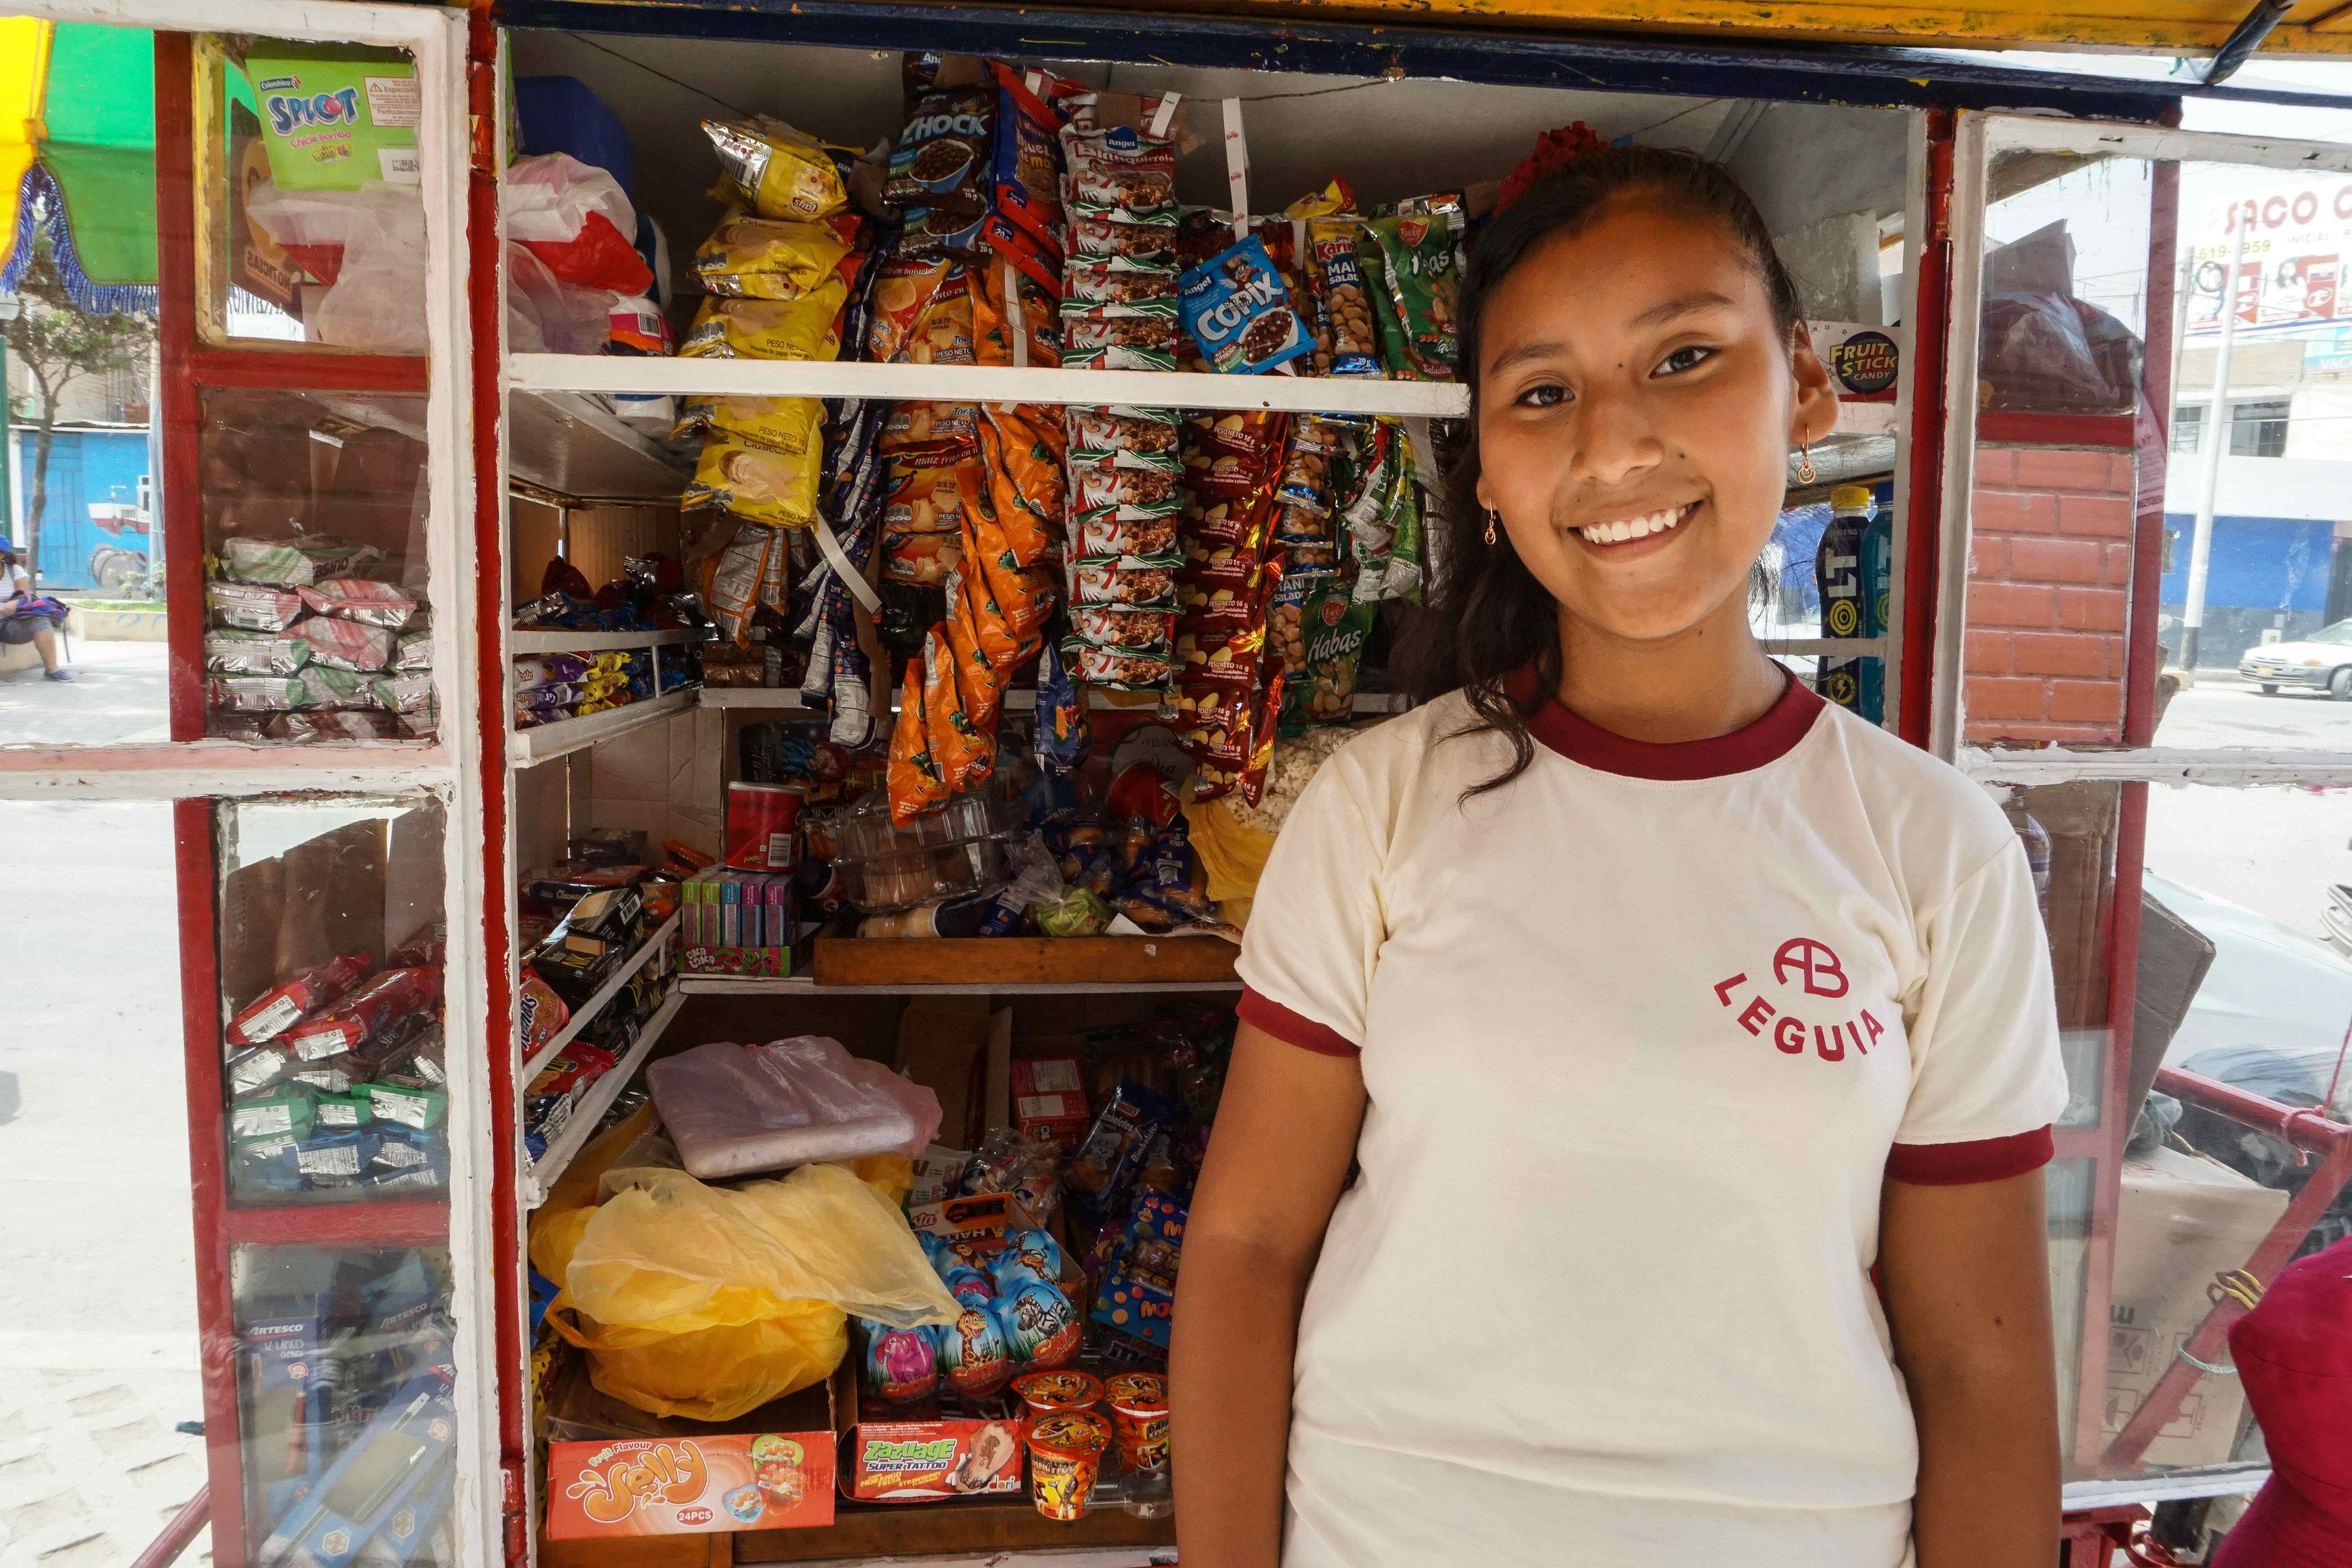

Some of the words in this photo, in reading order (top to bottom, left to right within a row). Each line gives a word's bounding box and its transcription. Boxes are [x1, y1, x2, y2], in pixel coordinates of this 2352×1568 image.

[268, 87, 359, 136] SPLOT
[1108, 139, 1135, 148] Angel
[1184, 276, 1212, 296] Angel
[766, 339, 784, 349] PESO
[1829, 342, 1889, 365] FRUIT
[1841, 355, 1898, 377] STICK
[1853, 371, 1891, 381] CANDY
[759, 426, 777, 437] PESO
[778, 431, 797, 442] NETO
[1214, 426, 1227, 435] PESO
[1228, 428, 1243, 439] NETO
[778, 509, 796, 519] PESO
[1307, 628, 1362, 663] Habas
[1713, 972, 1885, 1062] LEGUIA
[249, 1324, 303, 1335] ARTESCO
[588, 1448, 614, 1467] Fruit
[612, 1441, 652, 1453] Flavour
[905, 1461, 947, 1470] TATTOO
[583, 1440, 710, 1523] Jelly
[989, 1475, 1015, 1490] dori
[678, 1511, 712, 1521] 24PCS
